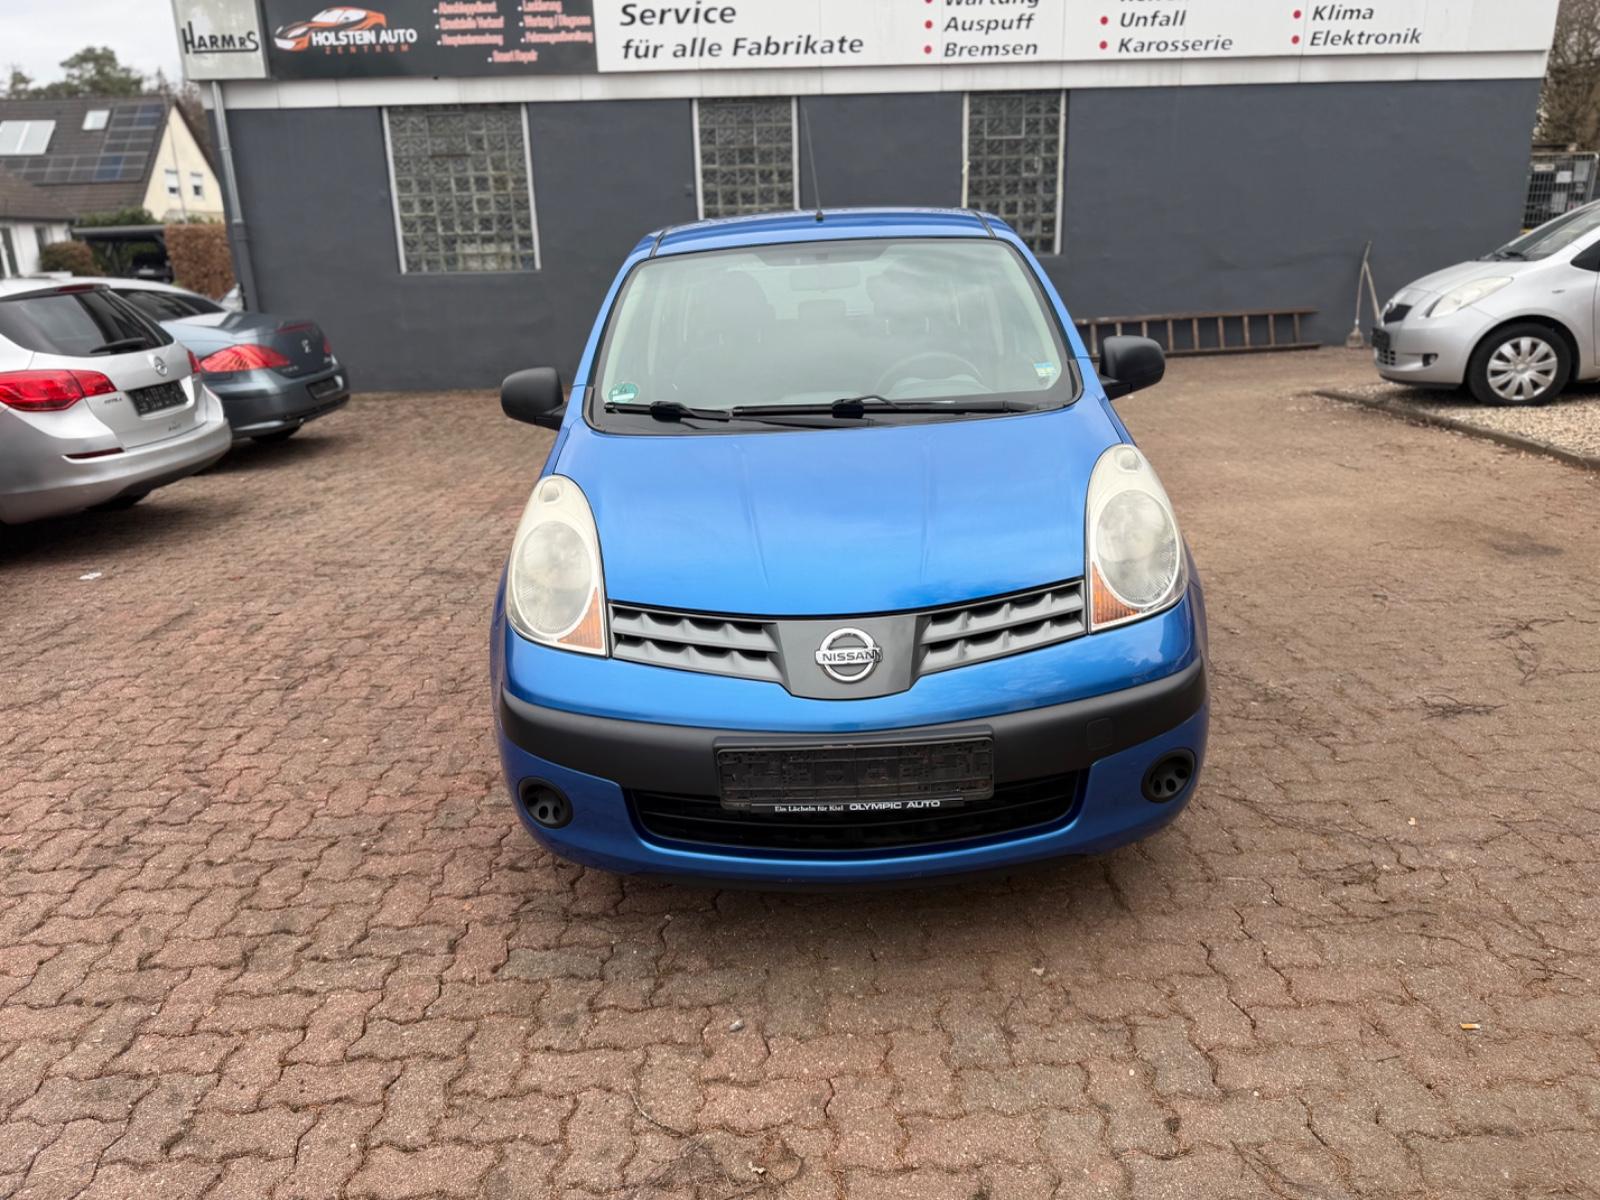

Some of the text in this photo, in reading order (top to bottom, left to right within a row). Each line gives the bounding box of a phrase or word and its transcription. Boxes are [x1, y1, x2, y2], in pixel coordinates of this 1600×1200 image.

[619, 1, 737, 26] Service
[1120, 10, 1186, 28] Unfall
[1312, 4, 1374, 21] Klima
[943, 13, 1035, 35] Auspuff
[311, 28, 418, 46] HOLSTEIN AUTO
[1117, 35, 1233, 53] Karosserie
[1309, 28, 1422, 46] Elektronik
[324, 44, 410, 55] ZENTRUM
[621, 35, 864, 59] für alle Fabrikate
[943, 41, 1038, 57] Bremsen
[822, 649, 876, 662] NISSAN
[849, 802, 903, 811] OLYMPIC
[906, 801, 940, 809] AUTO
